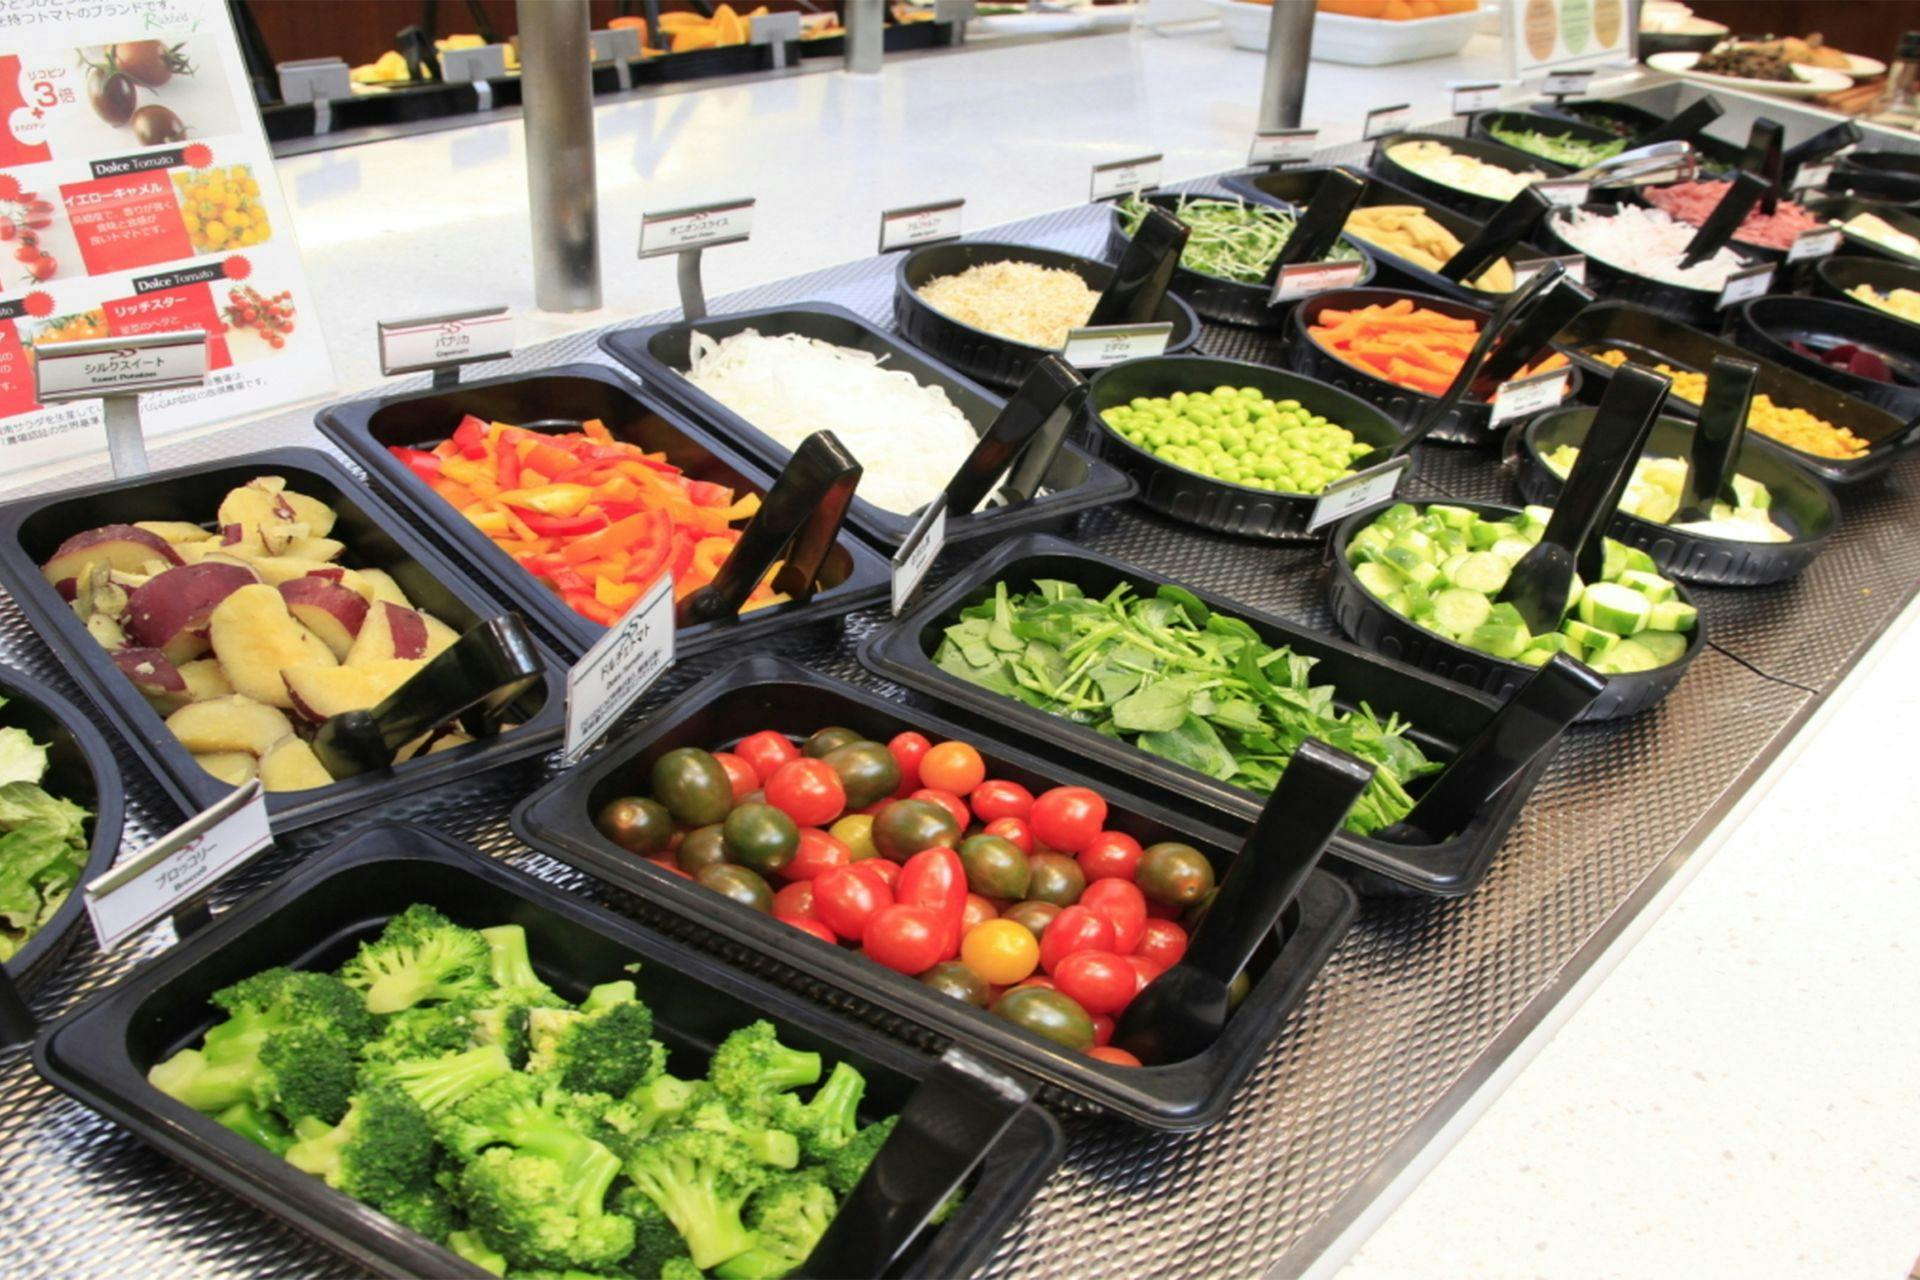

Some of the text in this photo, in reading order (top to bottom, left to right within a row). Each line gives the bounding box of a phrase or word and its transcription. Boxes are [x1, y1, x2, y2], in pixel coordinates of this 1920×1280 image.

[95, 155, 174, 175] Dolce Tomato
[63, 182, 163, 207] イエローキャメル
[138, 268, 214, 292] Dolce Tomato
[115, 296, 188, 318] リッチスター
[84, 356, 166, 375] シルクスイート
[154, 843, 218, 890] ブロッコリー
